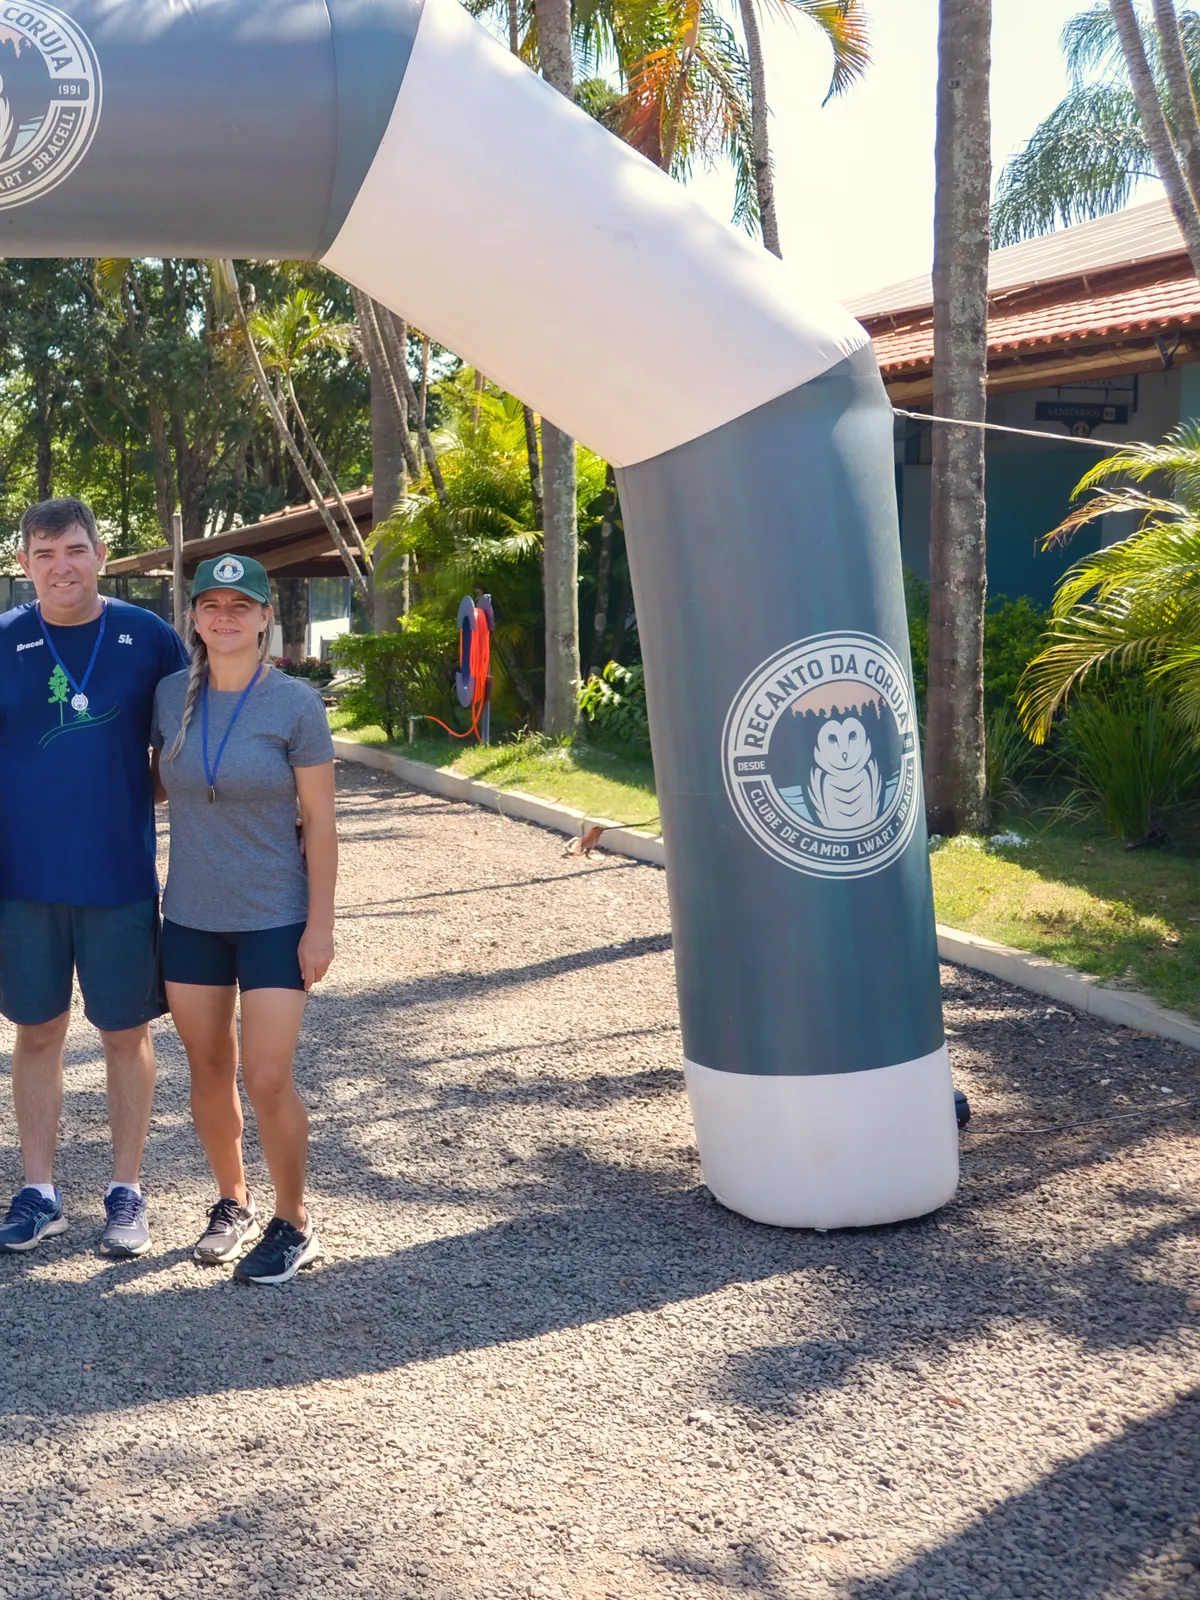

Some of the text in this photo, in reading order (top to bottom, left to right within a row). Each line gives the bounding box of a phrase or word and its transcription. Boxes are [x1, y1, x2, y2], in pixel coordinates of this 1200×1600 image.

[3, 6, 73, 72] CORUJA
[58, 85, 81, 95] 1991
[31, 112, 75, 172] BRACELL
[16, 638, 44, 652] Bracell
[118, 634, 133, 645] 5k
[743, 653, 908, 749] RECANTO DA CORUJA
[737, 760, 766, 771] DESDE
[750, 763, 913, 857] CLUBE DE CAMPO LWART BRACELL
